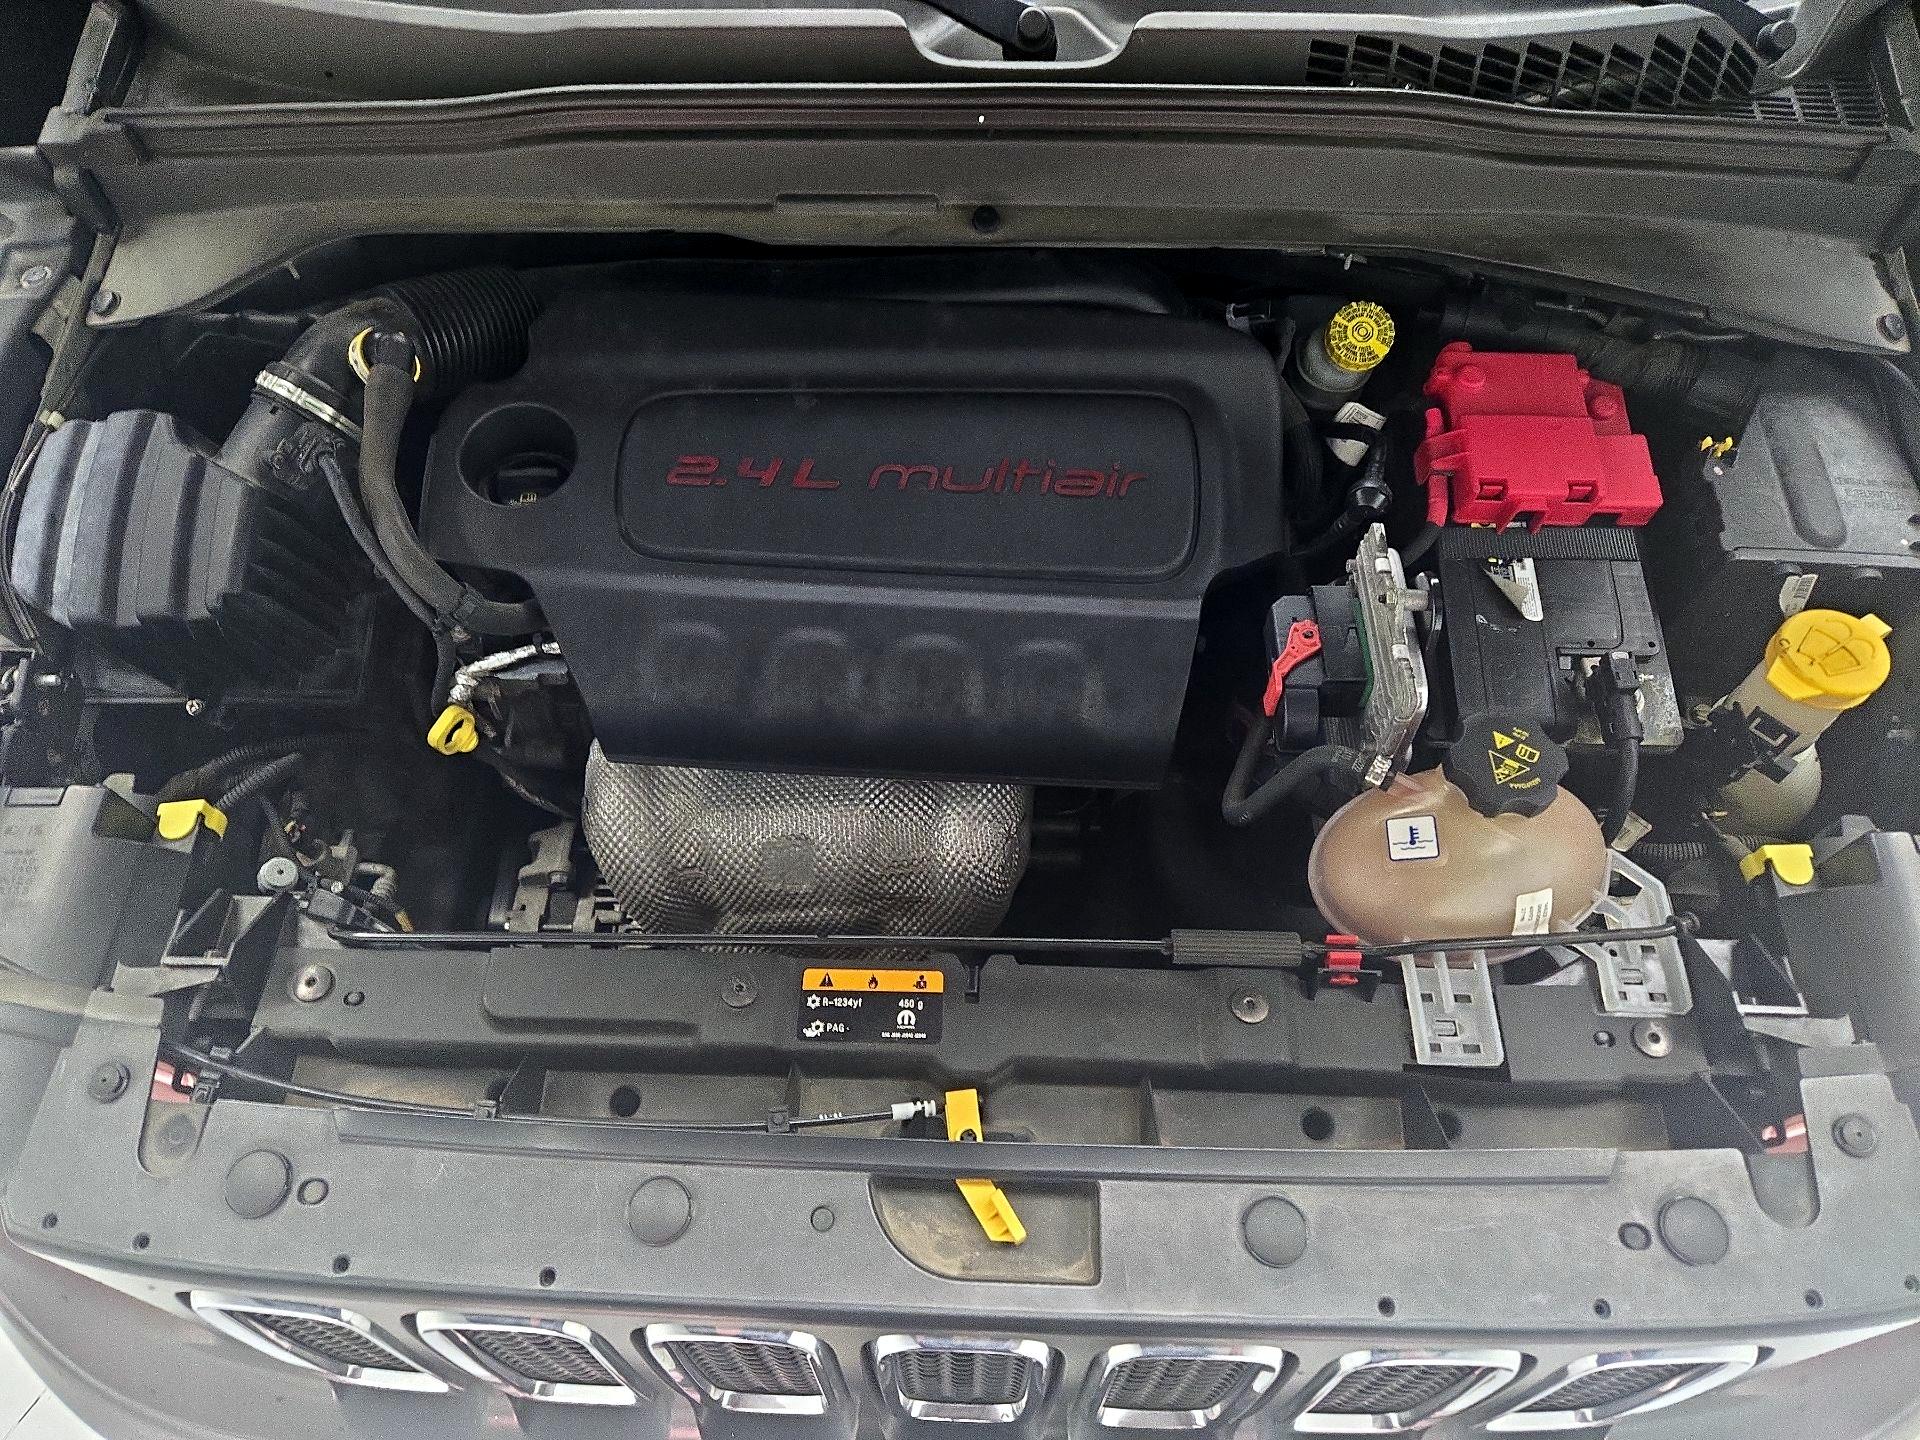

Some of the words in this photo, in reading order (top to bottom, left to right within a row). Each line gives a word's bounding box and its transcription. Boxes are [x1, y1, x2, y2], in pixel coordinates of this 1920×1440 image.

[868, 457, 1148, 498] multiair
[822, 996, 863, 1009] R-1234yf
[898, 998, 915, 1009] 450
